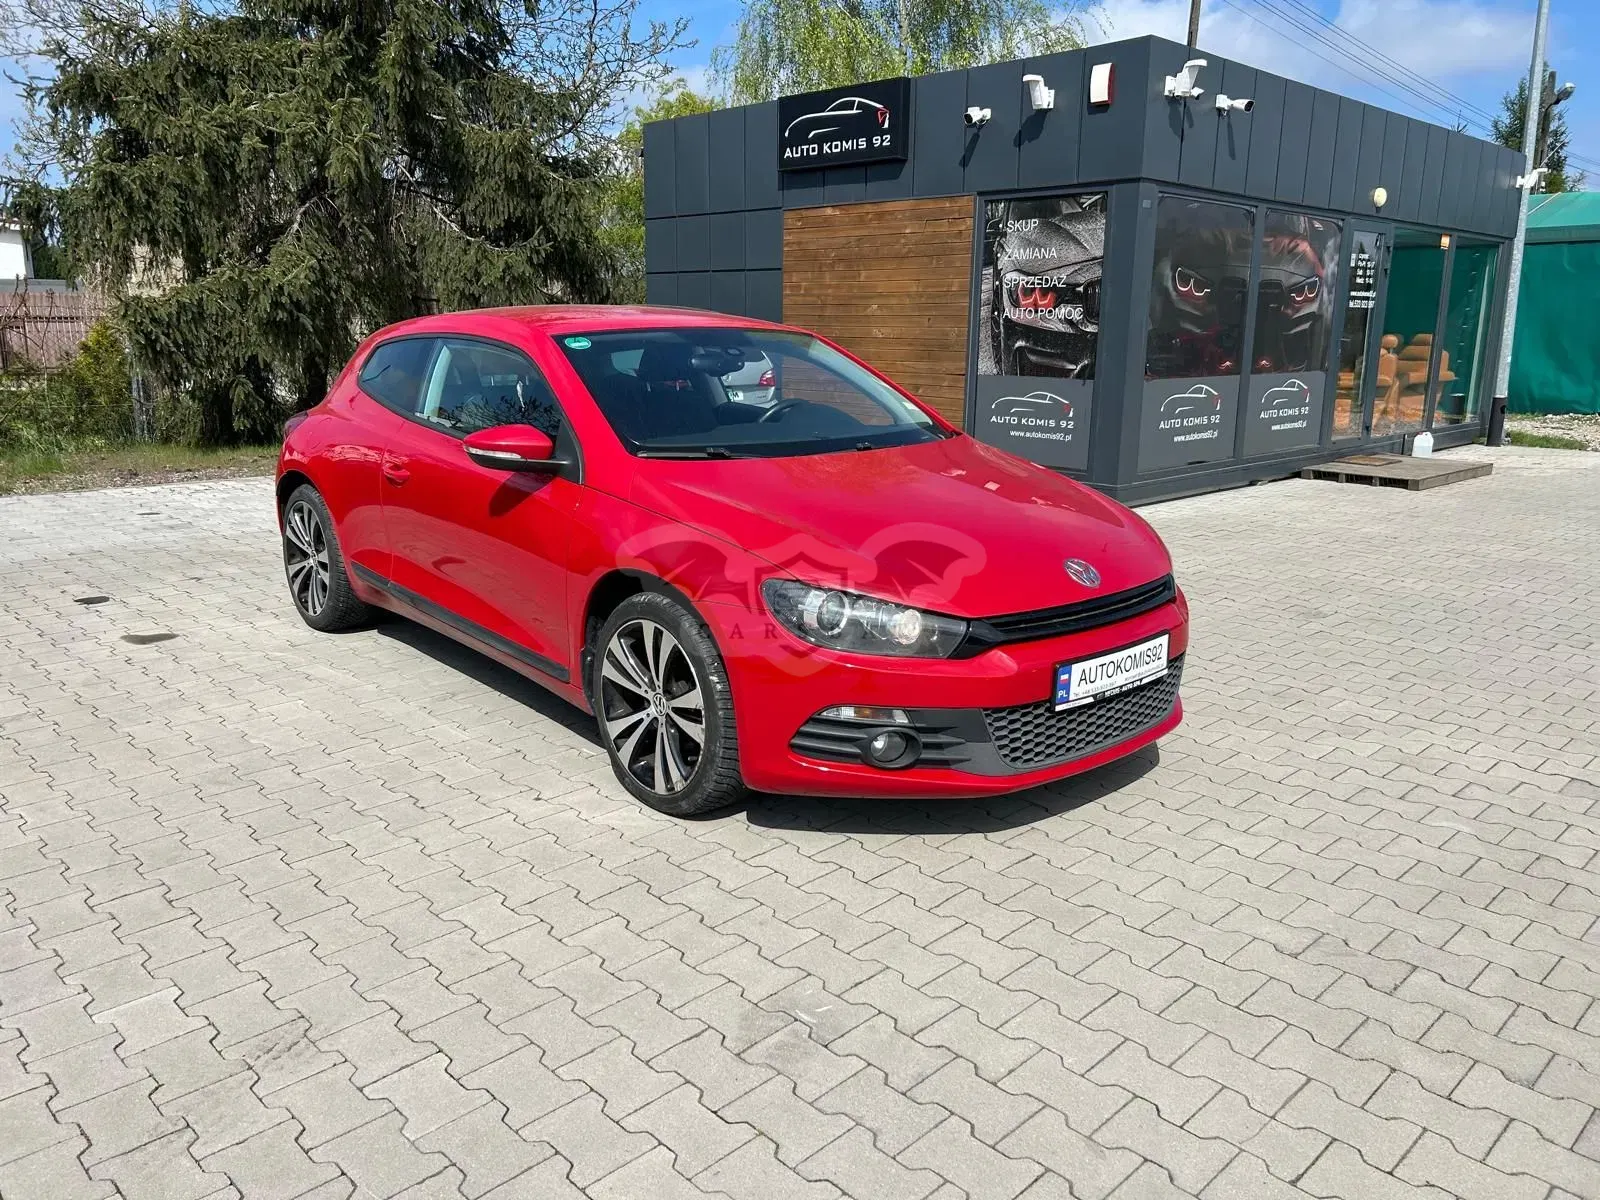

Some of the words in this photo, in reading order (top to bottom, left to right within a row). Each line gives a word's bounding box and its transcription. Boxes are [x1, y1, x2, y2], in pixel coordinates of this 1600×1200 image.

[784, 144, 818, 159] AUTO
[823, 138, 867, 154] KOMIS
[873, 134, 891, 147] 92
[1006, 219, 1039, 232] SKUP
[1004, 247, 1057, 260] ZAMIANA
[1002, 307, 1035, 319] AUTO
[1038, 307, 1084, 320] POMOC
[1260, 410, 1278, 419] AUTO
[1279, 408, 1299, 417] KOMIS
[990, 415, 1018, 424] AUTO
[1021, 417, 1056, 427] KOMIS
[1060, 420, 1074, 429] 92
[1159, 418, 1181, 429] AUTO
[1183, 416, 1208, 426] KOMIS
[1210, 414, 1220, 424] 92
[1009, 430, 1072, 442] www.autokomis92.pl
[1077, 643, 1163, 687] AUTOKOMIS92
[1058, 689, 1068, 699] PL
